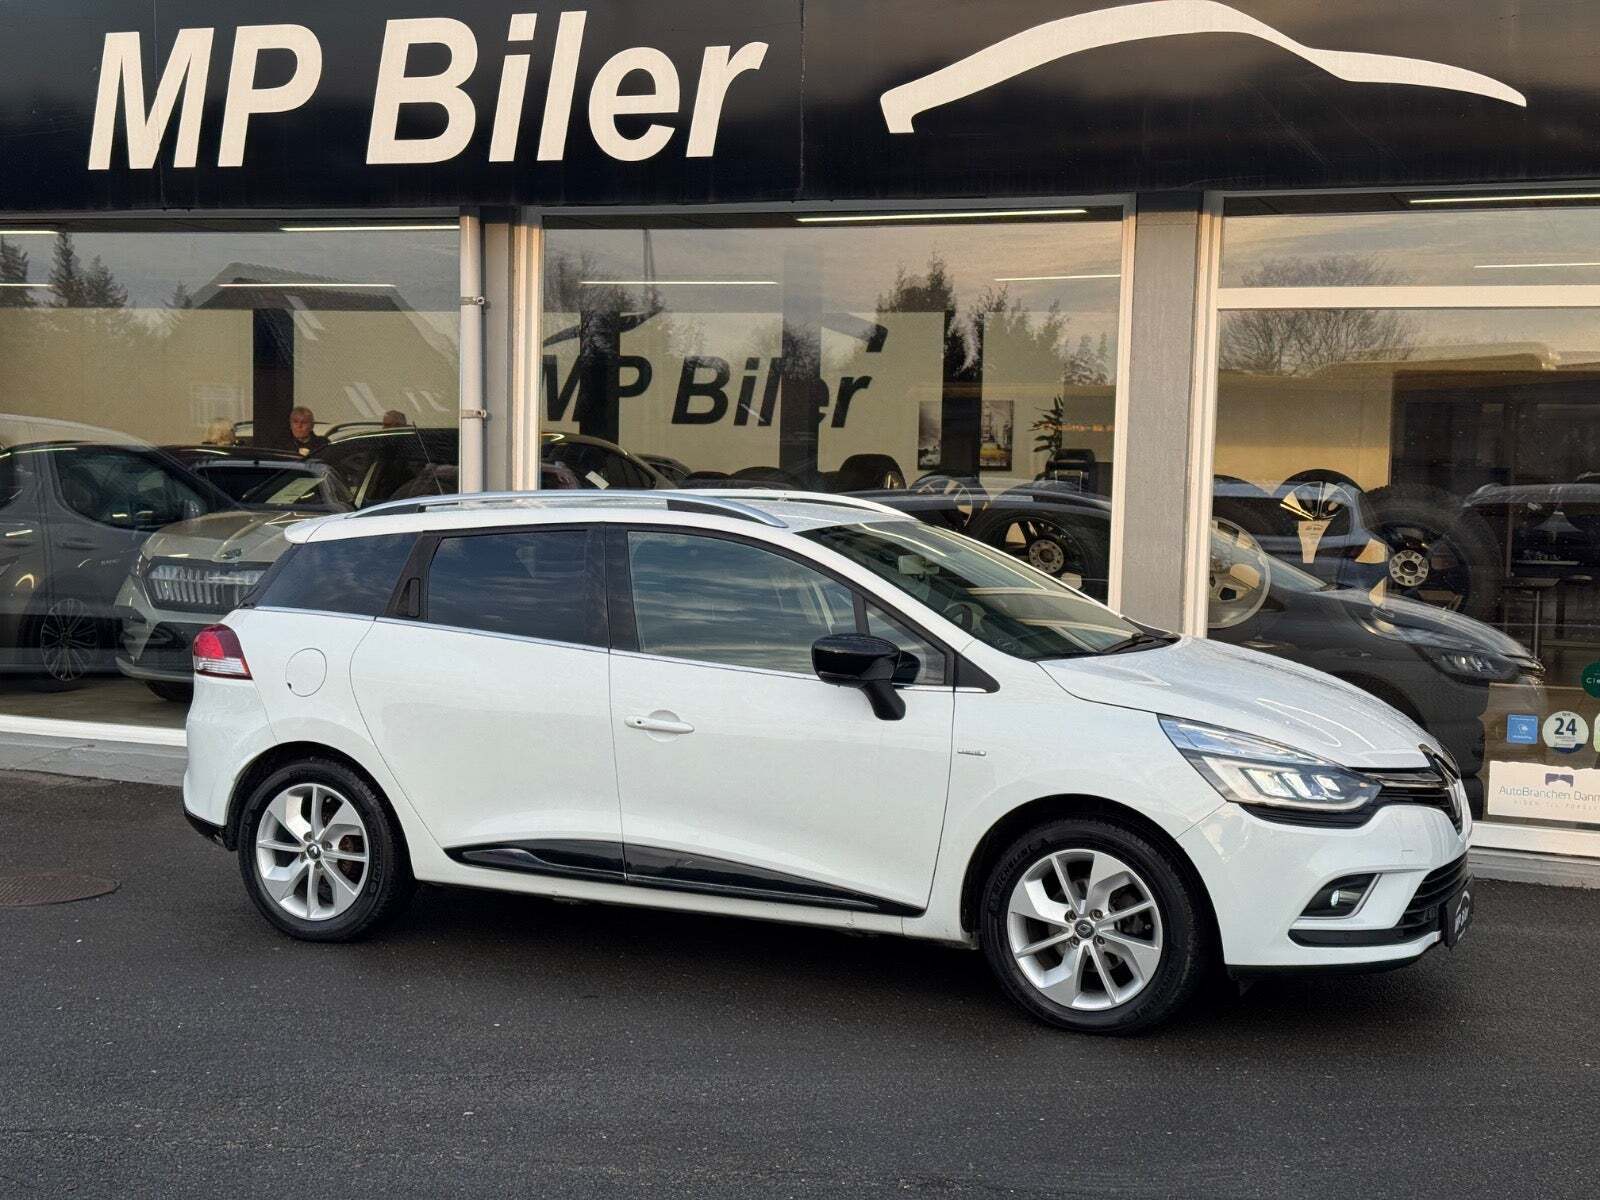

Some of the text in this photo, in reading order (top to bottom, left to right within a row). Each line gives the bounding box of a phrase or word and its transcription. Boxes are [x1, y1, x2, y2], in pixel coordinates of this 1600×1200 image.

[88, 11, 768, 170] MP Biler
[671, 355, 873, 429] Bilr
[1554, 717, 1577, 736] 24
[1499, 785, 1570, 801] AutoBranchen
